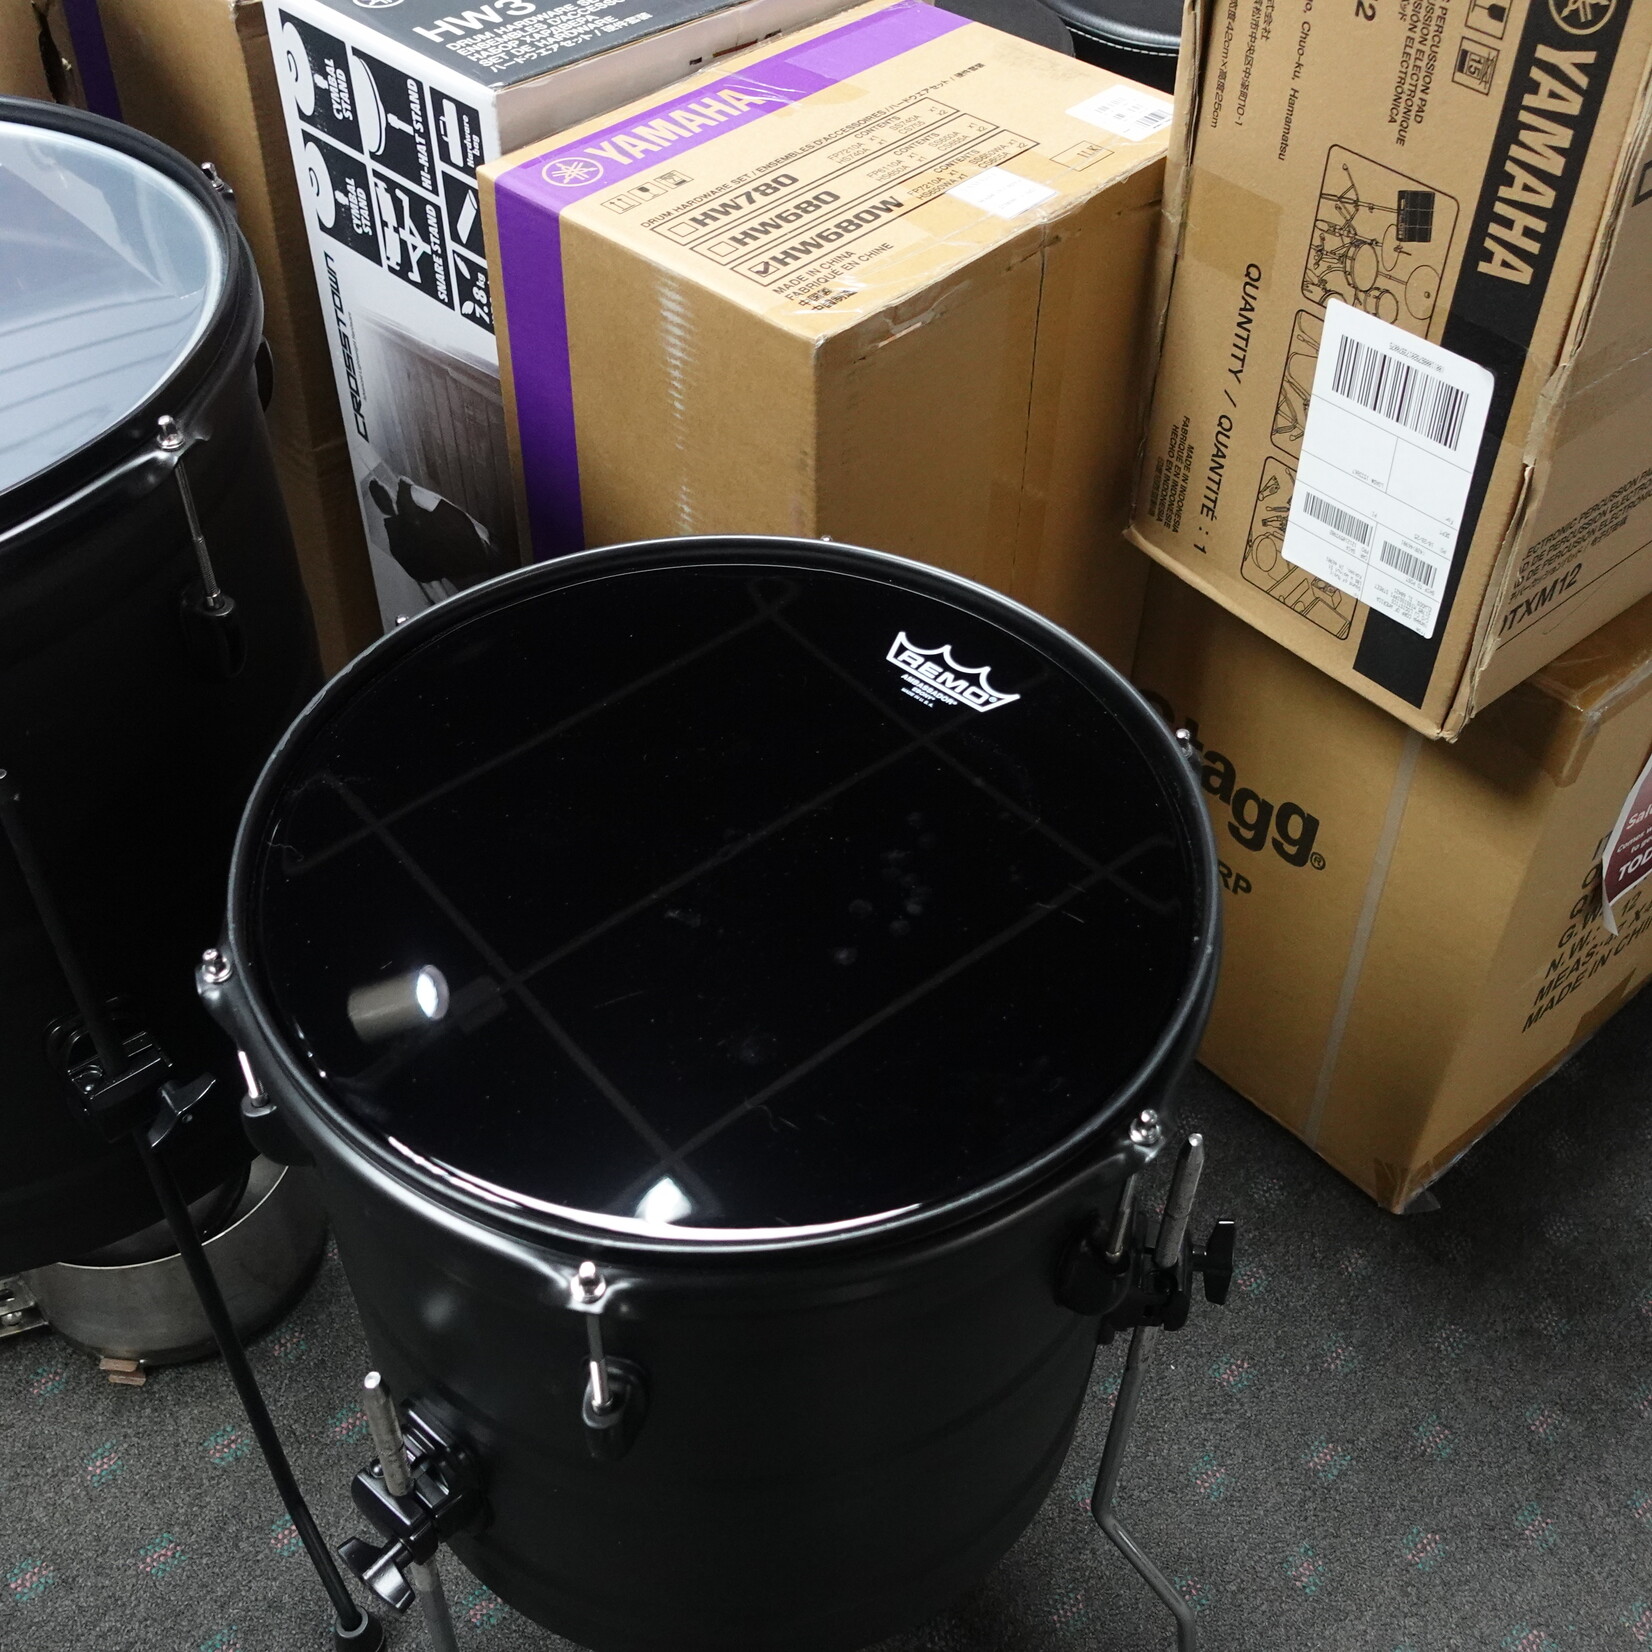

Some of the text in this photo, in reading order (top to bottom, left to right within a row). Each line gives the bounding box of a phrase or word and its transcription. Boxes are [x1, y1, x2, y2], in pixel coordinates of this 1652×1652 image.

[446, 3, 579, 51] DRUM HARDWARE
[456, 20, 549, 57] ENSEMBLES
[478, 15, 619, 67] SET DE HARDWARE
[1291, 20, 1311, 80] Chuo-ku,
[324, 58, 344, 120] CYMBAL
[1387, 35, 1415, 125] ELECTRÓNICA
[1414, 6, 1449, 125] PERCUSSION PAD
[335, 68, 354, 121] STAND
[1395, 48, 1426, 147] ELECTRONIQUE
[406, 78, 434, 191] HI-HAT STAND
[462, 114, 475, 169] Hardware
[472, 134, 481, 157] bag
[585, 88, 767, 166] YAMAHA
[853, 115, 901, 140] CONTENTS
[893, 132, 941, 156] CONTENTS
[1277, 87, 1300, 161] Hamamatsu
[640, 212, 675, 229] DRUM
[673, 183, 733, 214] HARDWARE
[729, 172, 753, 187] SET
[755, 143, 817, 174] ENSEMBLES
[814, 109, 888, 147] D'ACCESSOIRES
[933, 149, 981, 174] CONTENTS
[1477, 43, 1598, 286] YAMAHA
[345, 177, 364, 235] CYMBAL
[356, 187, 373, 236] STAND
[688, 173, 800, 228] HW780
[727, 190, 841, 247] HW680
[425, 204, 449, 304] SNARE STAND
[768, 195, 905, 268] HW680W
[472, 272, 491, 325] 7.8 kg
[772, 250, 857, 295] MADE IN CHINA
[784, 242, 895, 301] FABRIQUÉ EN CHINE
[323, 249, 370, 444] CROSSTOWN
[1228, 262, 1263, 384] QUANTITY
[1165, 459, 1174, 473] EN
[1167, 423, 1180, 459] HECHO
[1200, 414, 1234, 522] QUANTITÉ
[1156, 472, 1171, 523] INDONESIA
[1171, 444, 1195, 534] MADE IN INDONESIA
[1173, 464, 1182, 478] EN
[1193, 543, 1207, 555] 1
[896, 649, 990, 705] REMO
[1522, 967, 1588, 1034] MADE
[1588, 947, 1614, 979] IN
